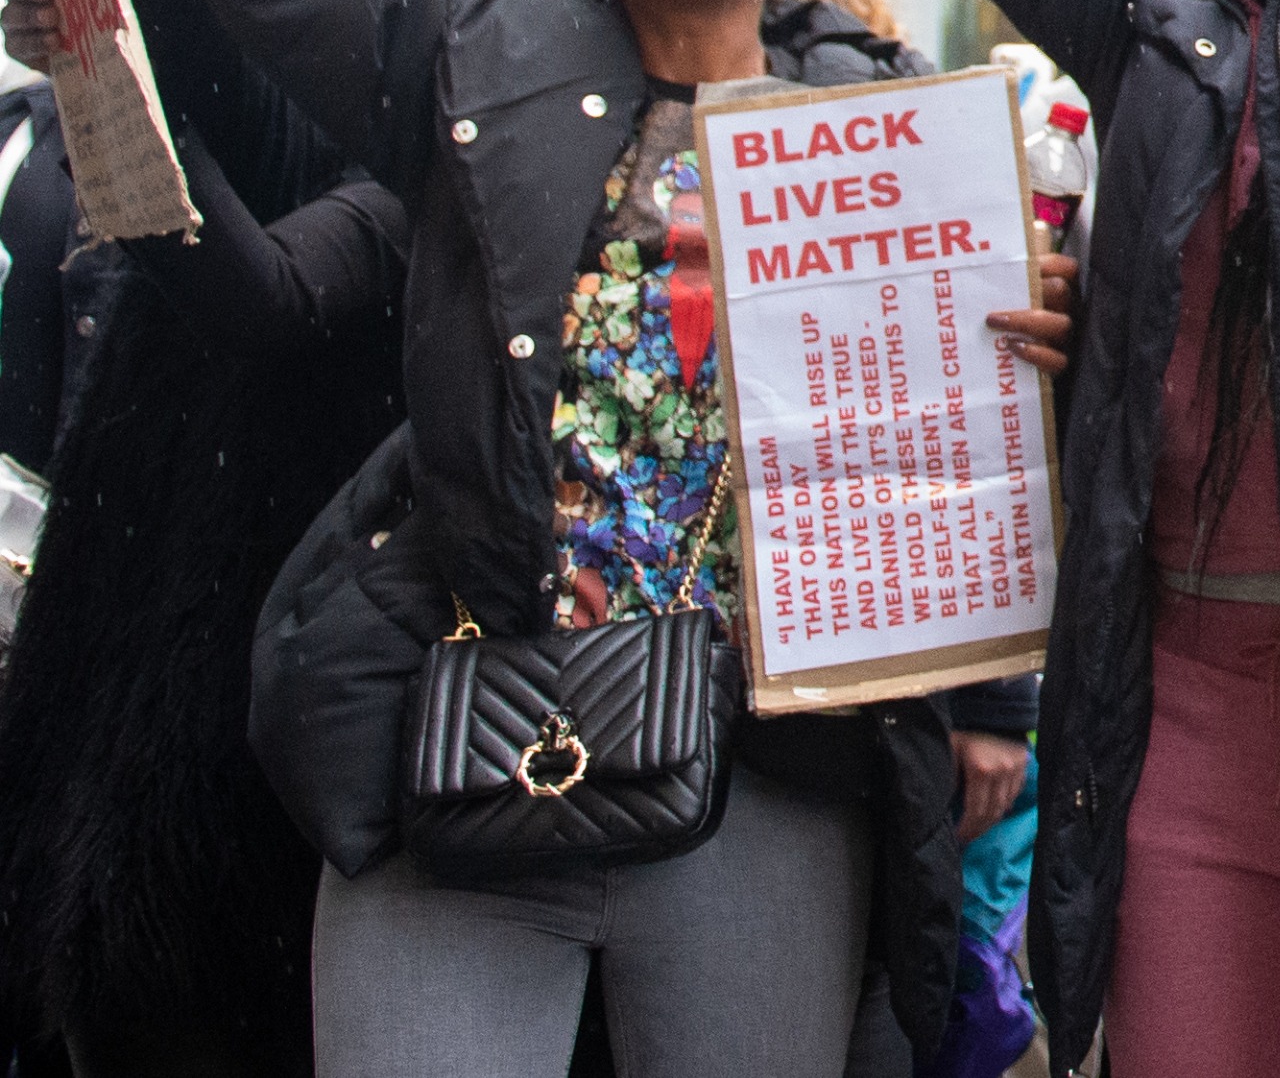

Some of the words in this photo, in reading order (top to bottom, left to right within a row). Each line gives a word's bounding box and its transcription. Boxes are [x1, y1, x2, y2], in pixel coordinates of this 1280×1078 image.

[733, 109, 923, 169] BLACK
[740, 171, 902, 226] LIVES
[747, 219, 991, 284] MATTER.
[801, 311, 821, 344] UP
[880, 283, 899, 317] TO
[933, 269, 961, 378] CREATED
[805, 350, 828, 407] RISE
[830, 333, 853, 399] TRUE
[858, 336, 883, 416] CREED
[884, 322, 910, 422] TRUTHS
[994, 336, 1017, 396] KING
[839, 405, 860, 454] THE
[945, 384, 966, 432] ARE
[812, 415, 834, 471] WILL
[867, 423, 888, 467] IT'S
[895, 427, 919, 504] THESE
[951, 439, 972, 490] MEN
[1002, 402, 1028, 496] LUTHER
[761, 436, 786, 517] DREAM
[789, 463, 811, 506] DAY
[844, 462, 866, 509] OUT
[873, 473, 892, 504] OF
[770, 524, 788, 541] A
[796, 514, 816, 566] ONE
[819, 477, 844, 569] NATION
[850, 516, 872, 571] LIVE
[905, 511, 927, 578] HOLD
[958, 497, 977, 541] ALL
[877, 511, 905, 627] MEANING
[1012, 503, 1037, 604] -MARTIN
[771, 549, 794, 616] HAVE
[801, 576, 823, 640] THAT
[829, 577, 851, 636] THIS
[857, 579, 878, 630] AND
[912, 585, 931, 623] WE
[939, 586, 958, 618] BE
[962, 551, 984, 614] THAT
